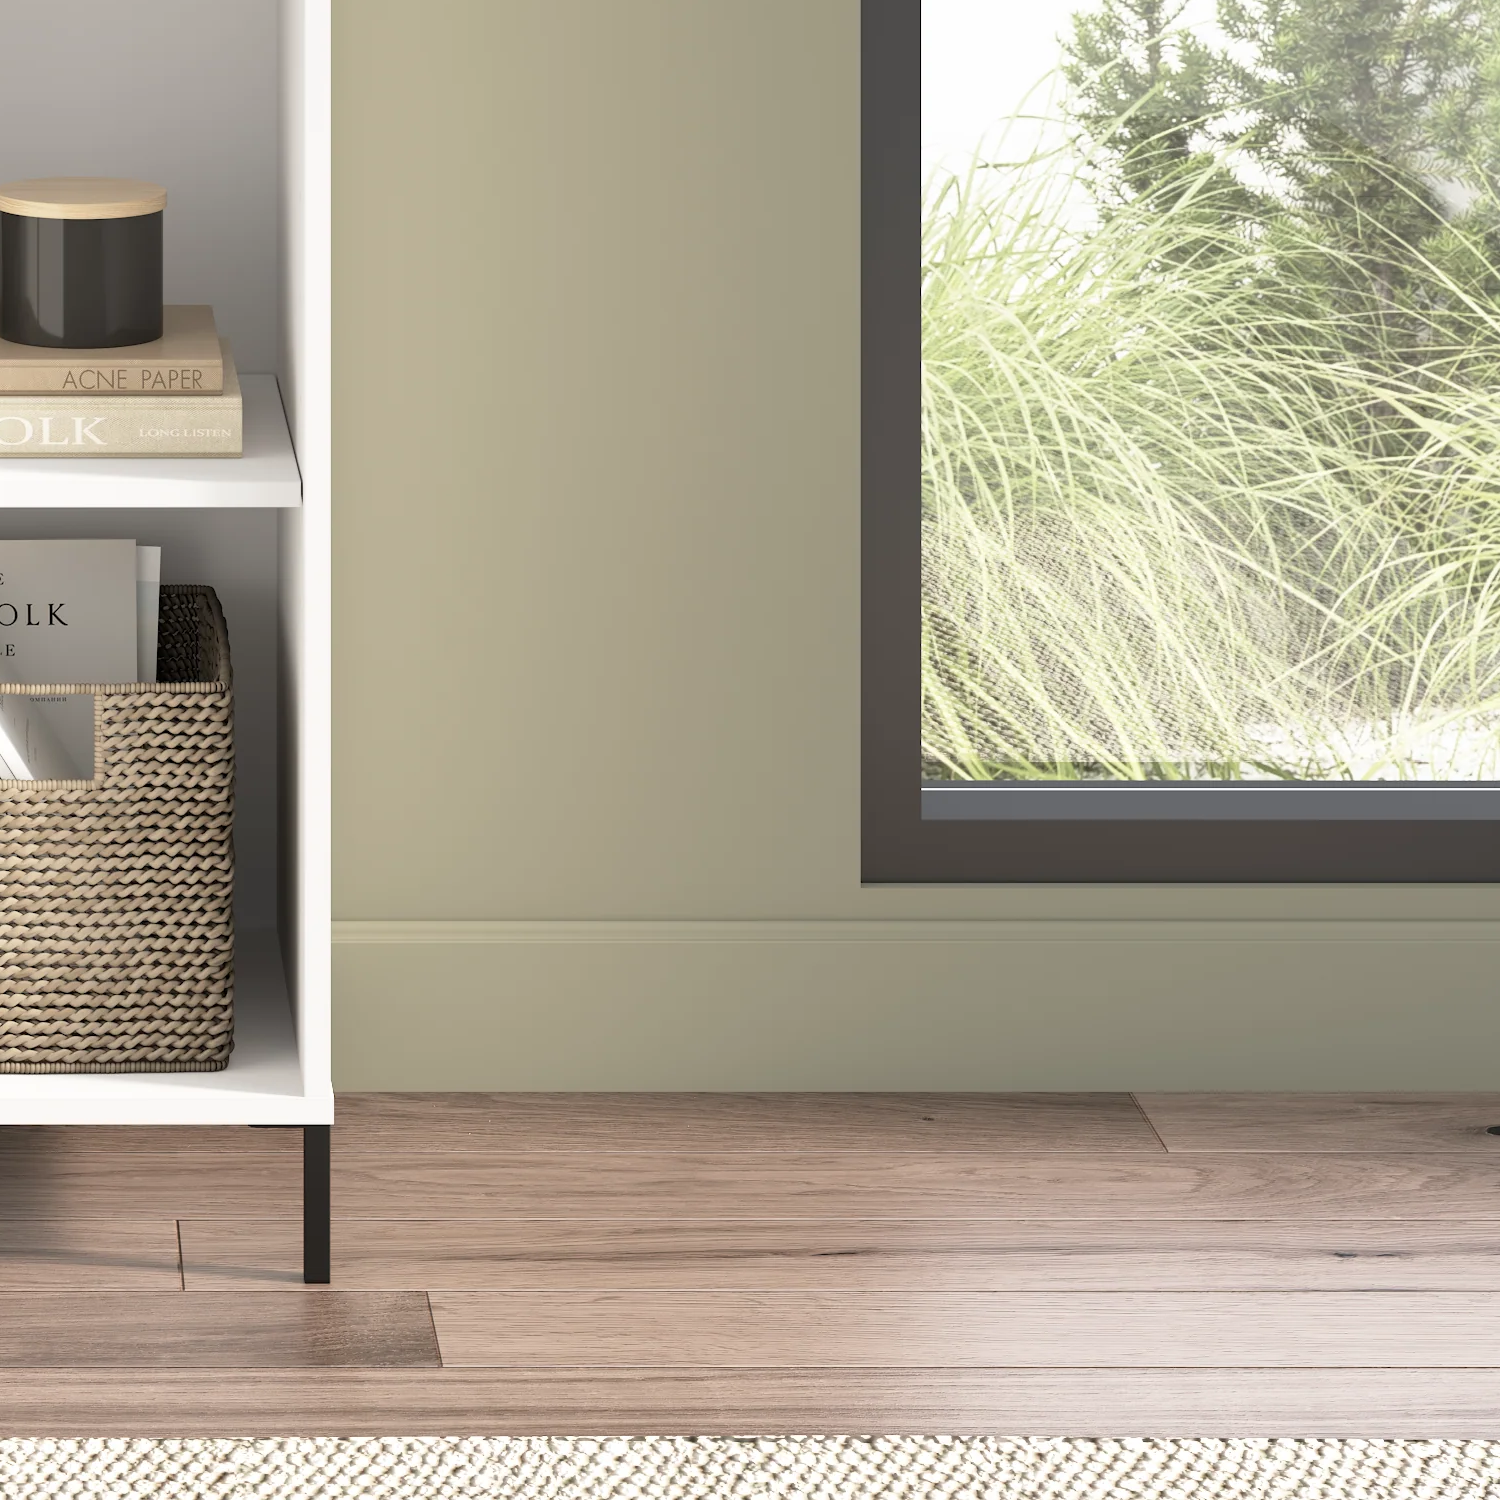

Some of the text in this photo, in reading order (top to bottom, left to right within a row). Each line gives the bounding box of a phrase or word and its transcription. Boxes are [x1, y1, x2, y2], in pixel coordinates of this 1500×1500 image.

[62, 369, 203, 390] ACNE PAPER
[140, 428, 180, 438] LONG
[184, 428, 232, 438] LISTEN
